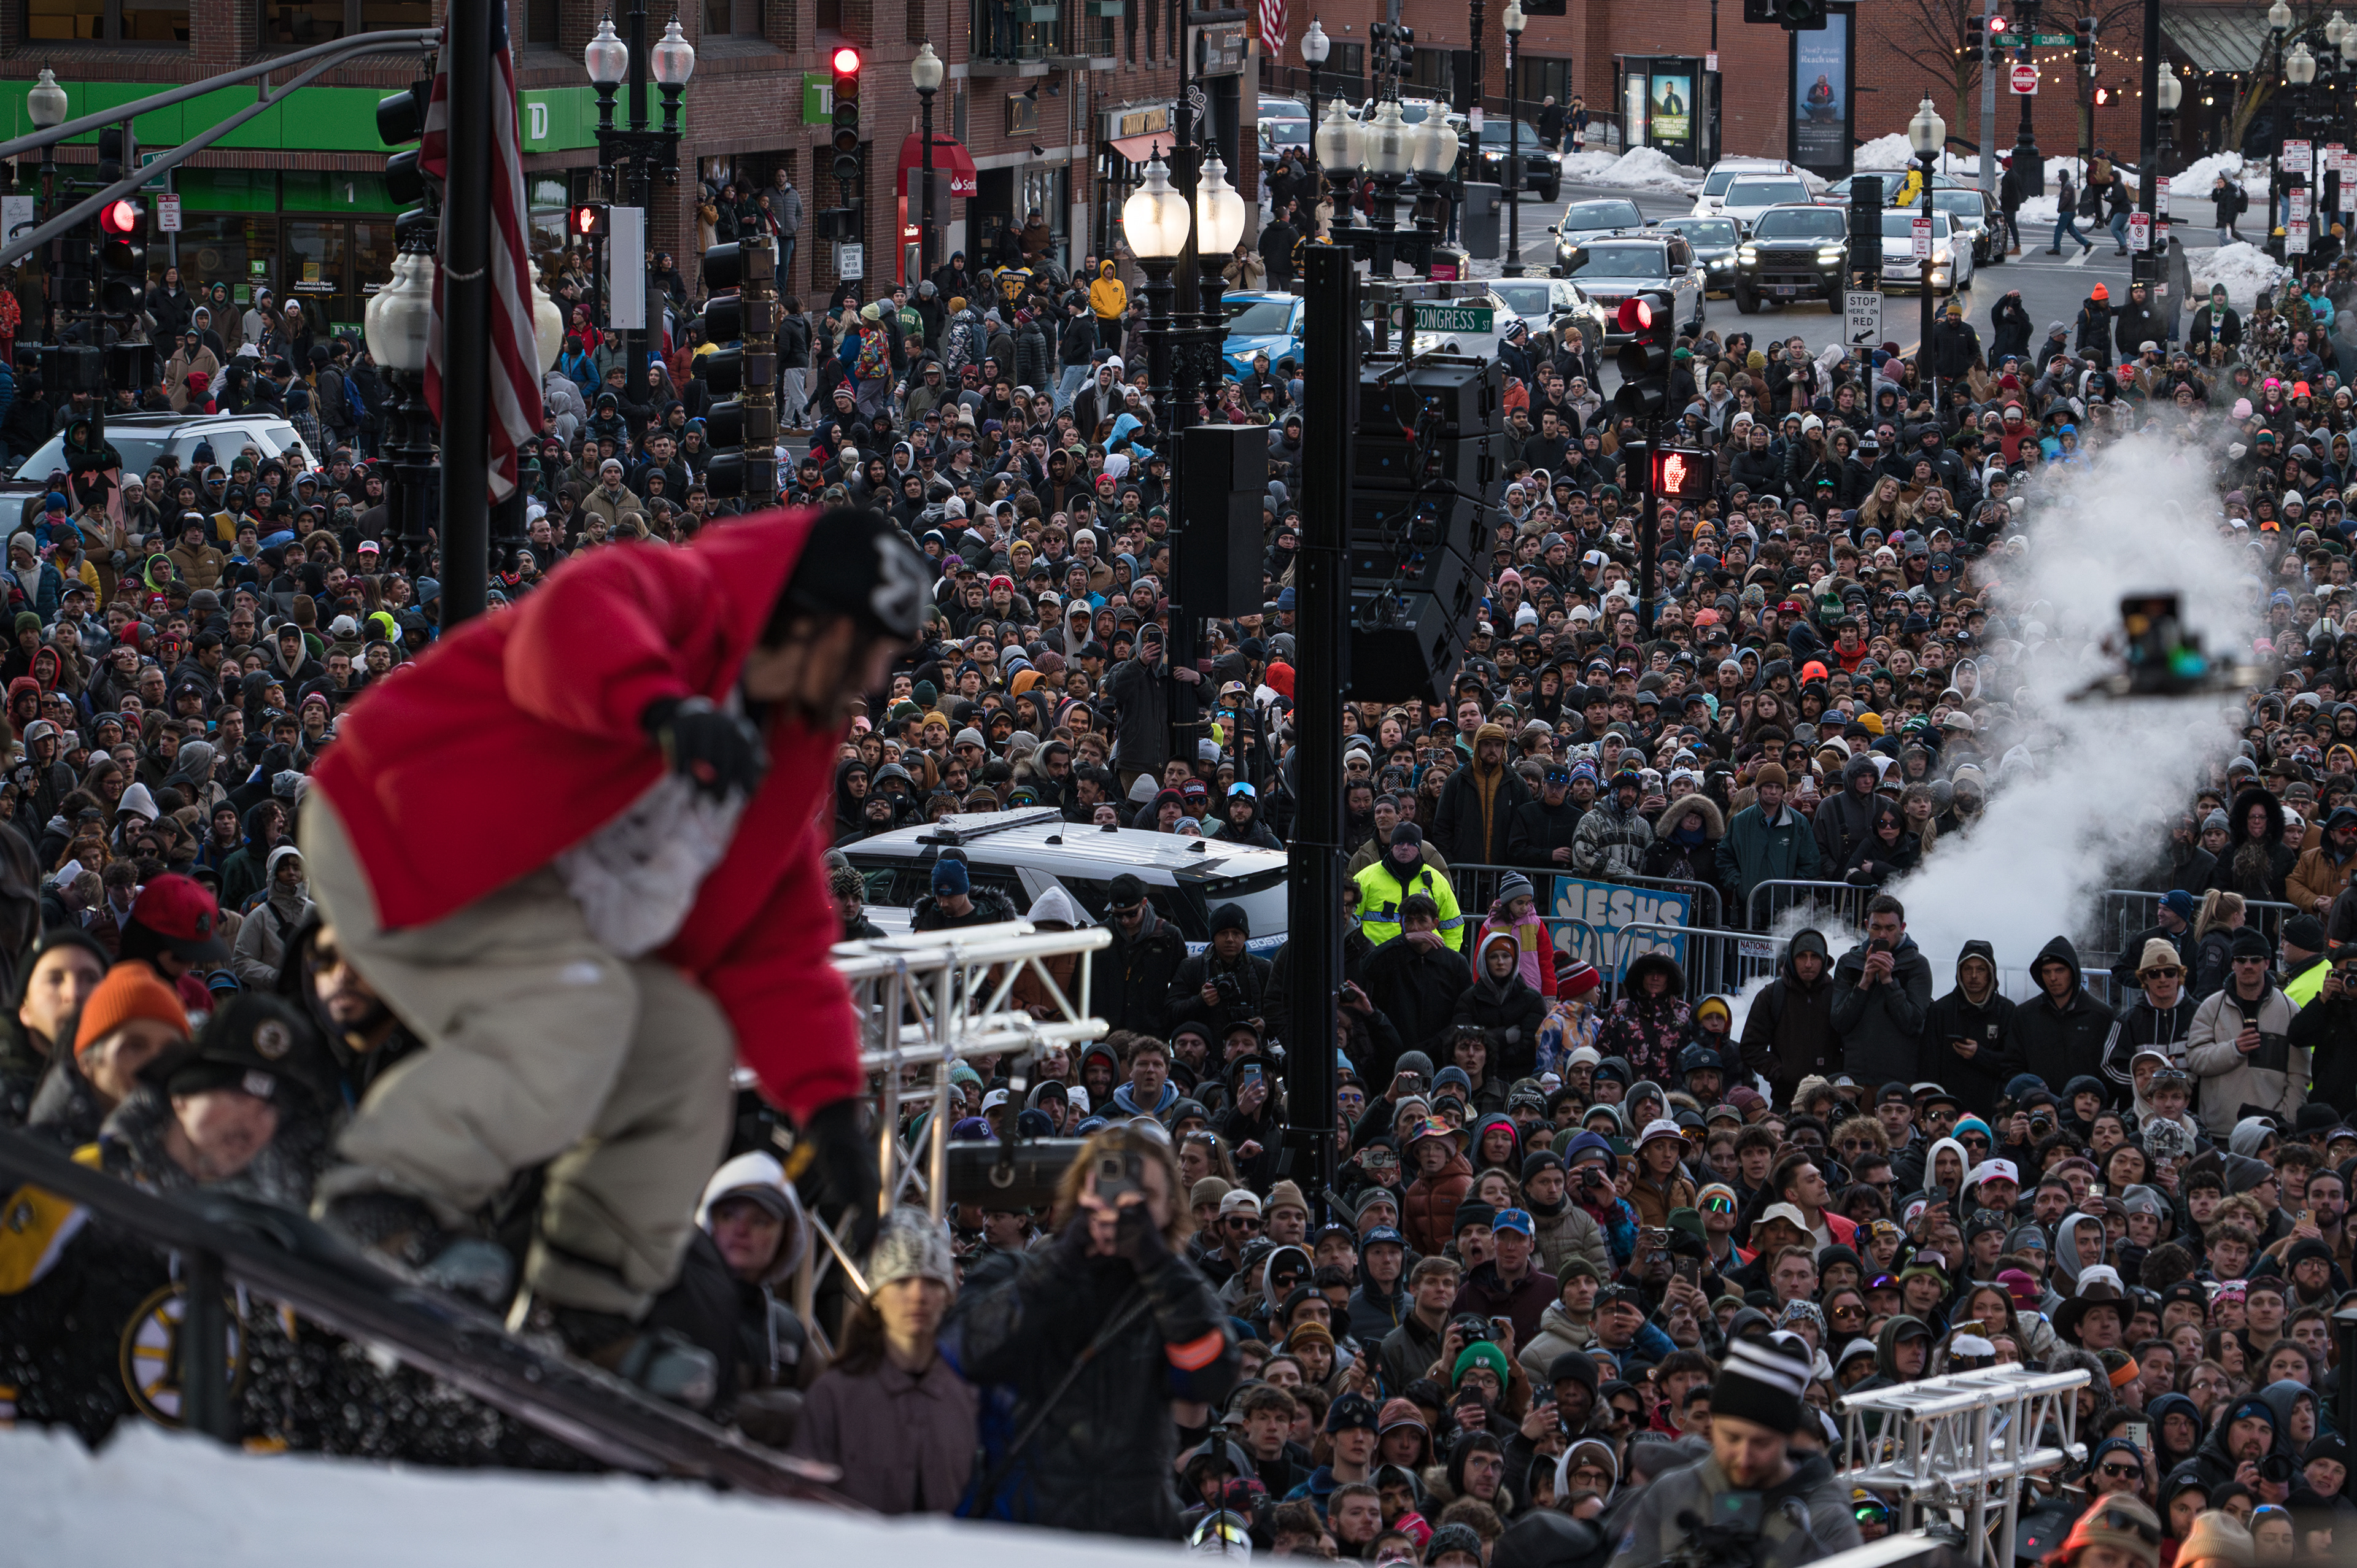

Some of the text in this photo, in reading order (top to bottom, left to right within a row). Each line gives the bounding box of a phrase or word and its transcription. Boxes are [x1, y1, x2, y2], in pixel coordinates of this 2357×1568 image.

[812, 84, 832, 114] T
[527, 102, 548, 139] TD
[344, 182, 354, 203] 1
[253, 262, 264, 271] TD
[1002, 280, 1026, 300] 88
[1850, 297, 1877, 306] STOP
[901, 314, 915, 325] TICS
[1414, 308, 1490, 330] CONGRESS ST
[1853, 317, 1873, 326] RED
[1557, 884, 1682, 938] JESUS
[1740, 940, 1774, 951] NATIONAL
[978, 1122, 989, 1136] B
